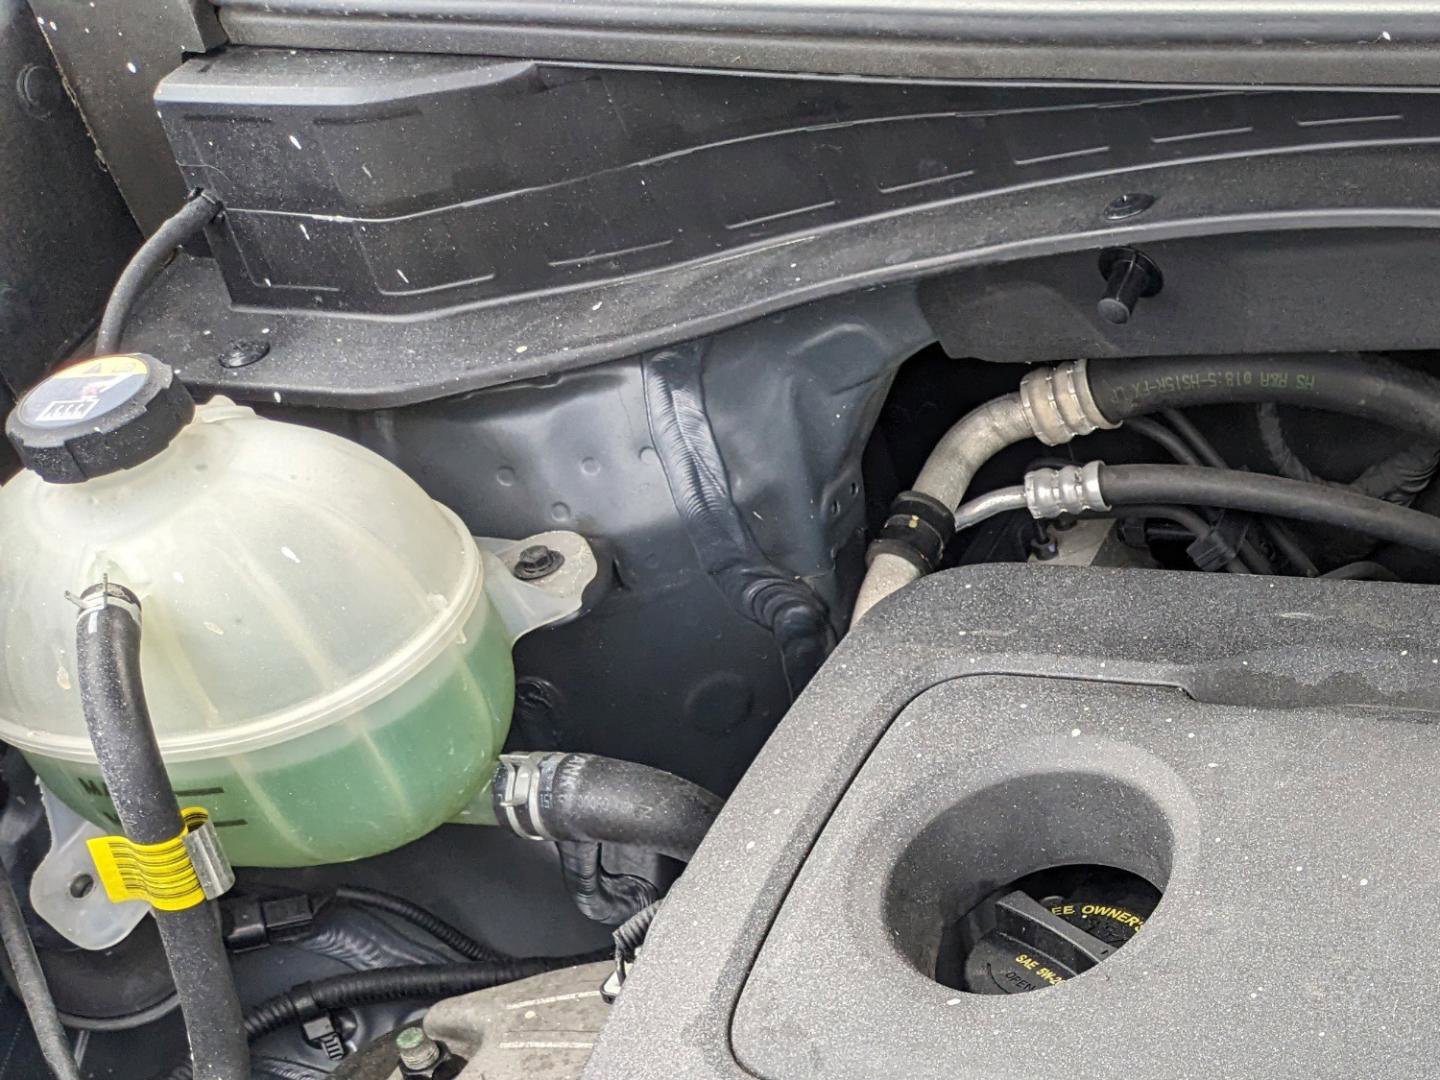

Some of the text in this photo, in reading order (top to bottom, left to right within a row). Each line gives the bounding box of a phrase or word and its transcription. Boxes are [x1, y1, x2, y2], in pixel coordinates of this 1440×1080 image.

[1051, 905, 1075, 916] EE
[1015, 954, 1063, 985] SAE 5W-2
